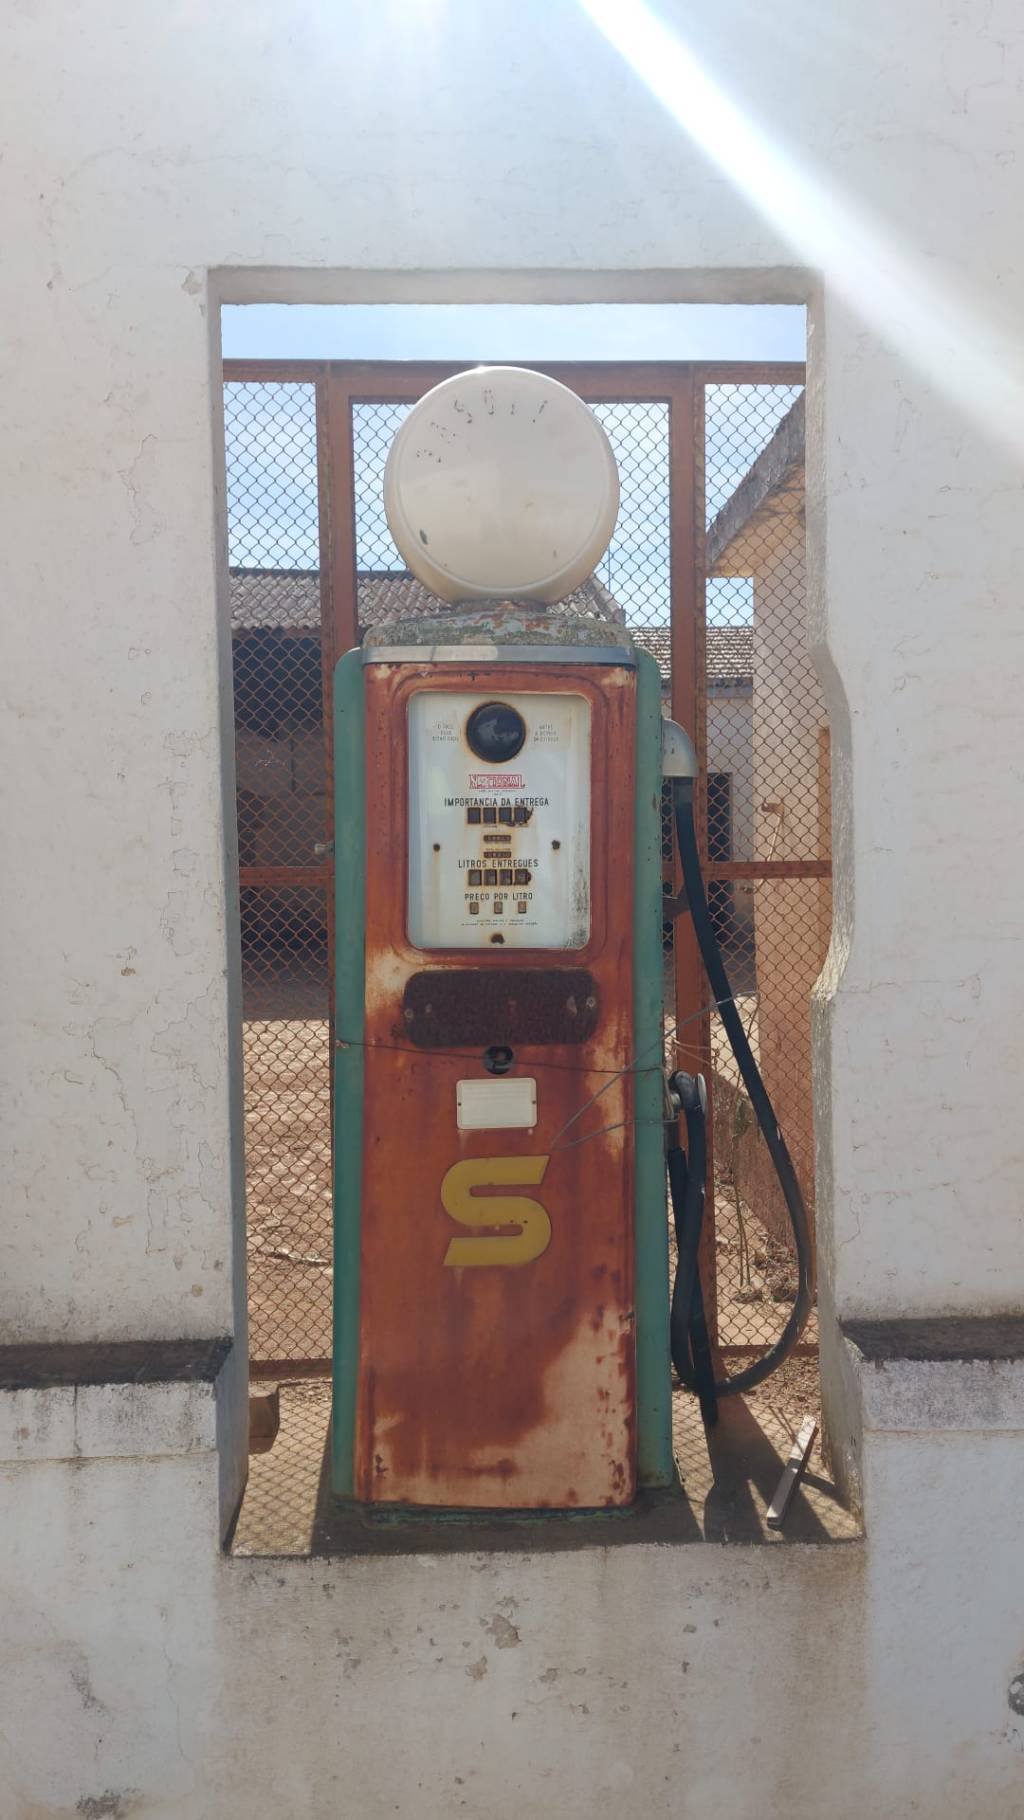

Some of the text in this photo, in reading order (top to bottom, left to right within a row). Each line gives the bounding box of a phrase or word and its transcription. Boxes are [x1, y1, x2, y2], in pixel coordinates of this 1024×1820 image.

[444, 798, 549, 808] IMPORTANCIA DA ENTREGA
[458, 859, 539, 868] LITROS ENTREGUES
[494, 893, 508, 901] POR
[512, 892, 533, 901] LITRO
[440, 1155, 552, 1267] S
